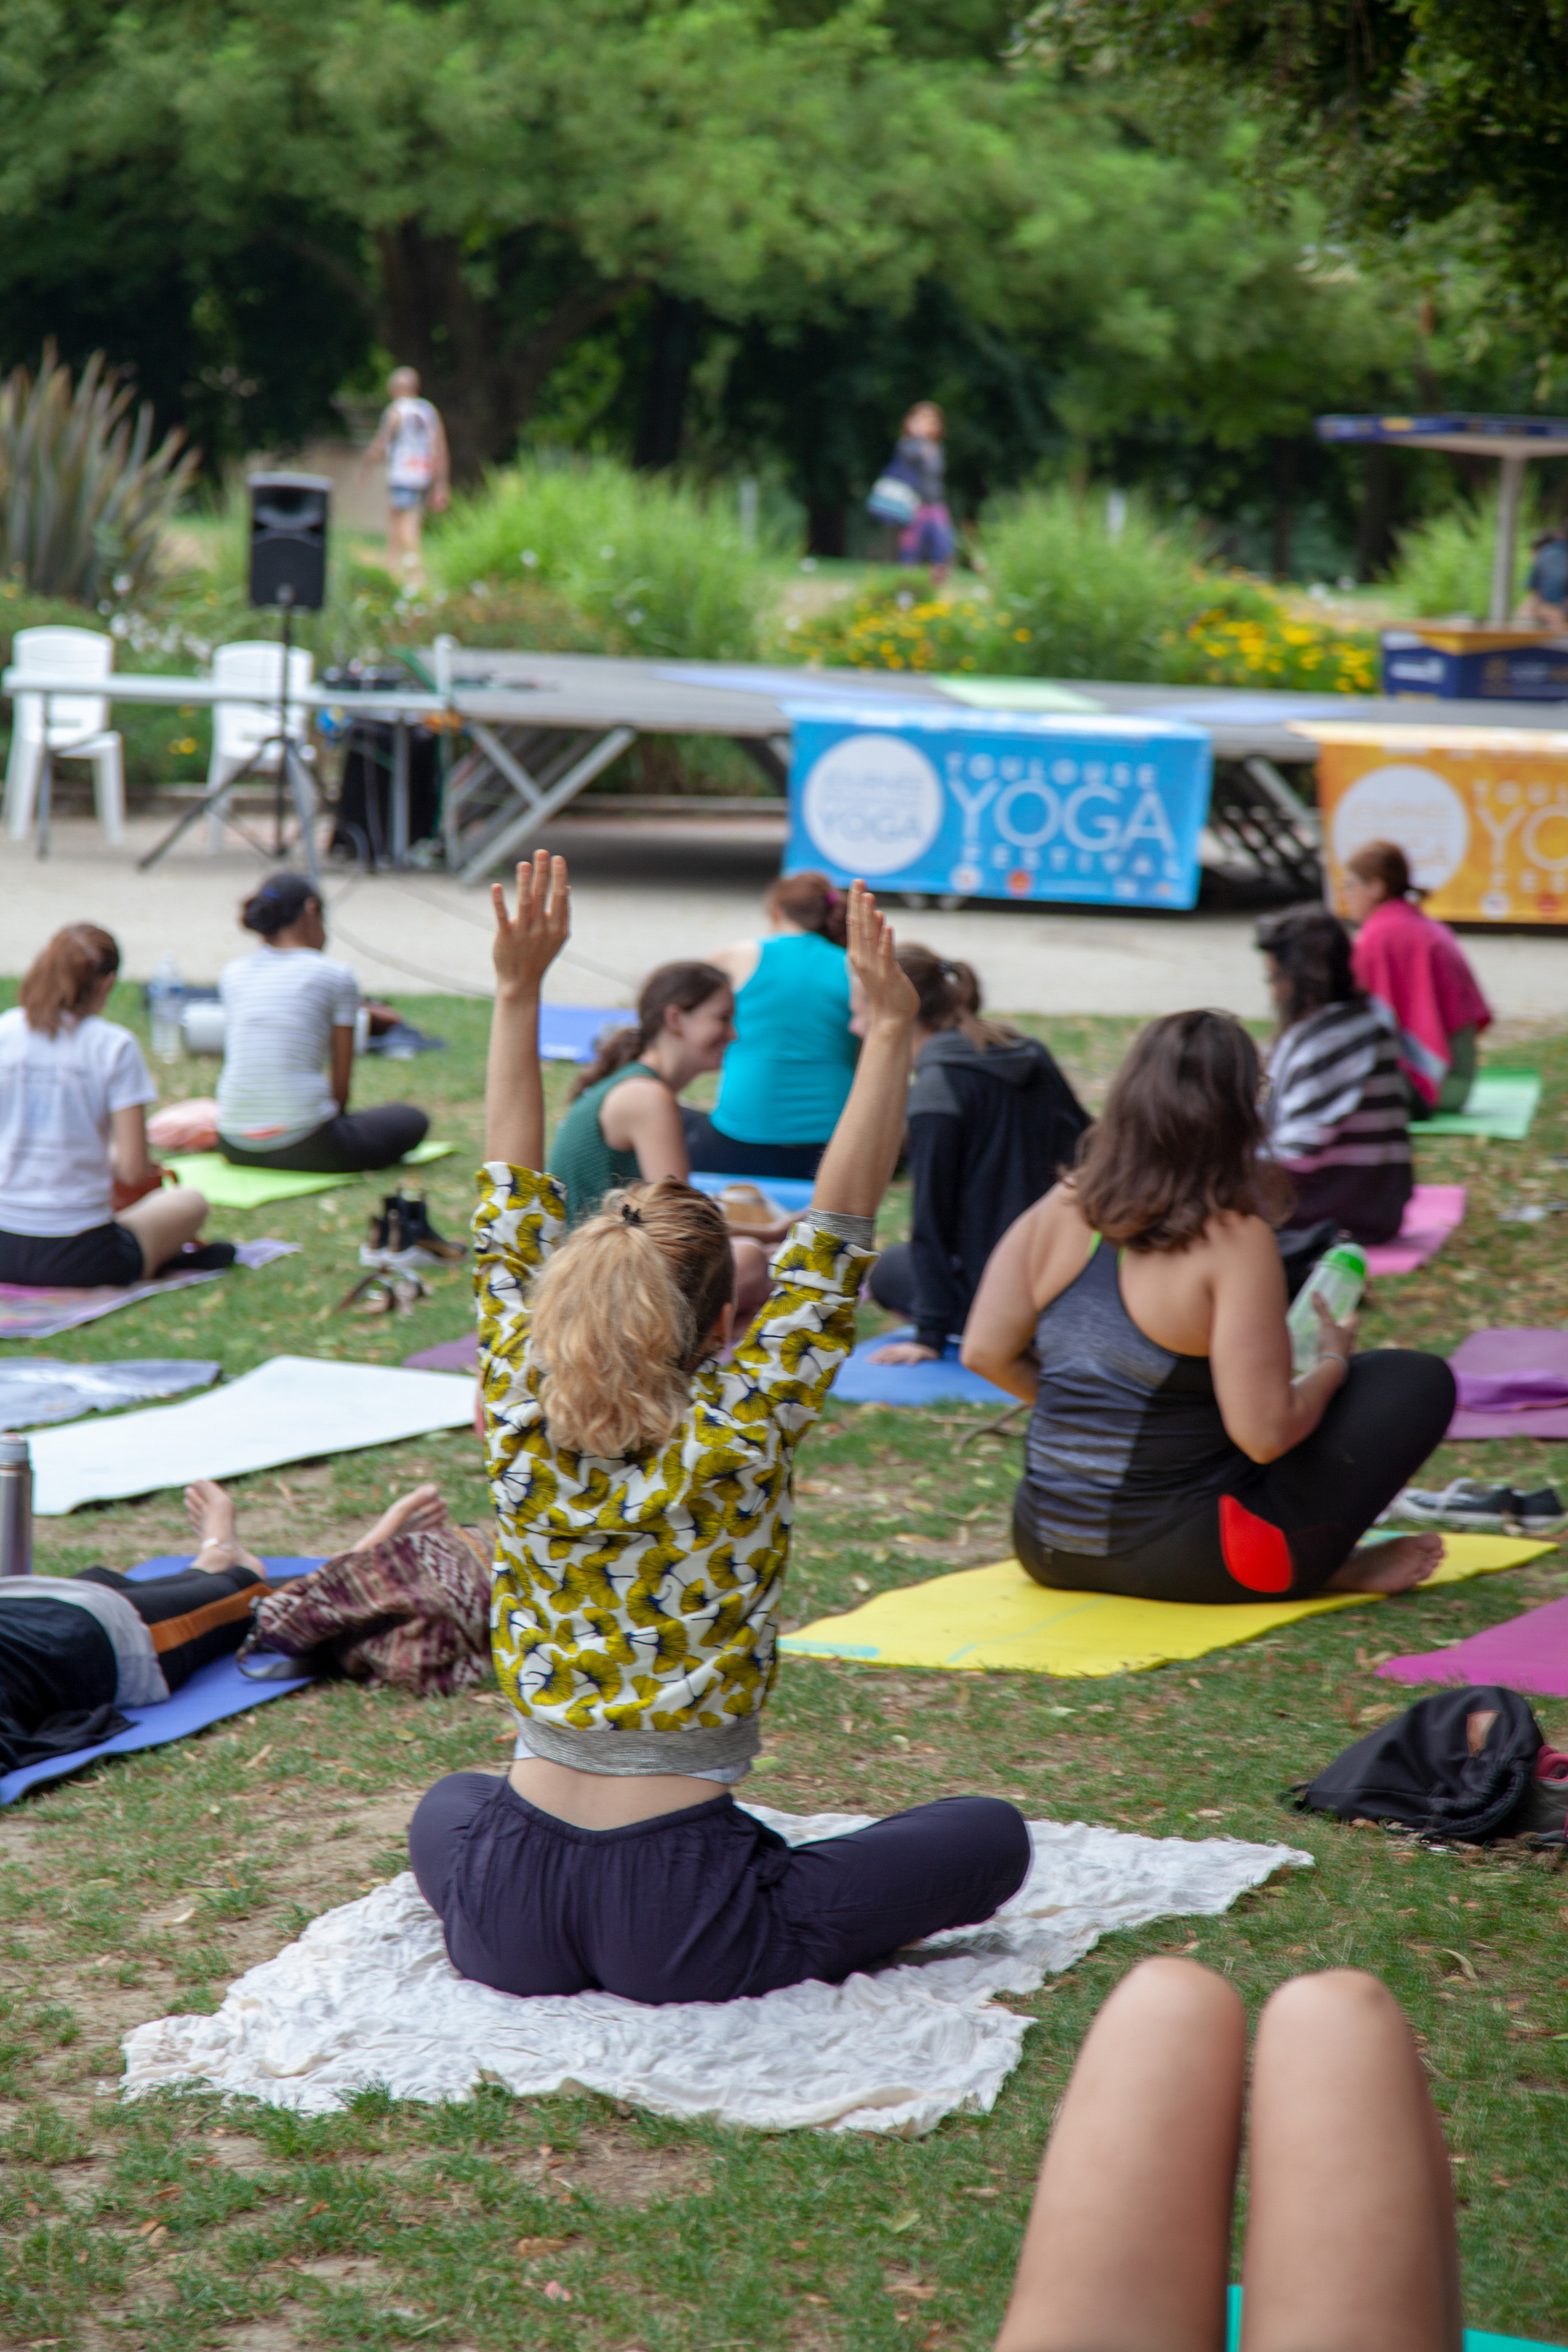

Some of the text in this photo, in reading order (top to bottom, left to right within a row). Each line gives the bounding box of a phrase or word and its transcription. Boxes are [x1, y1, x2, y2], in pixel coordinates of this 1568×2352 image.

[946, 752, 1157, 787] TOULOUSE
[948, 778, 1177, 854] YOGA
[962, 845, 1182, 878] FESTIVAL
